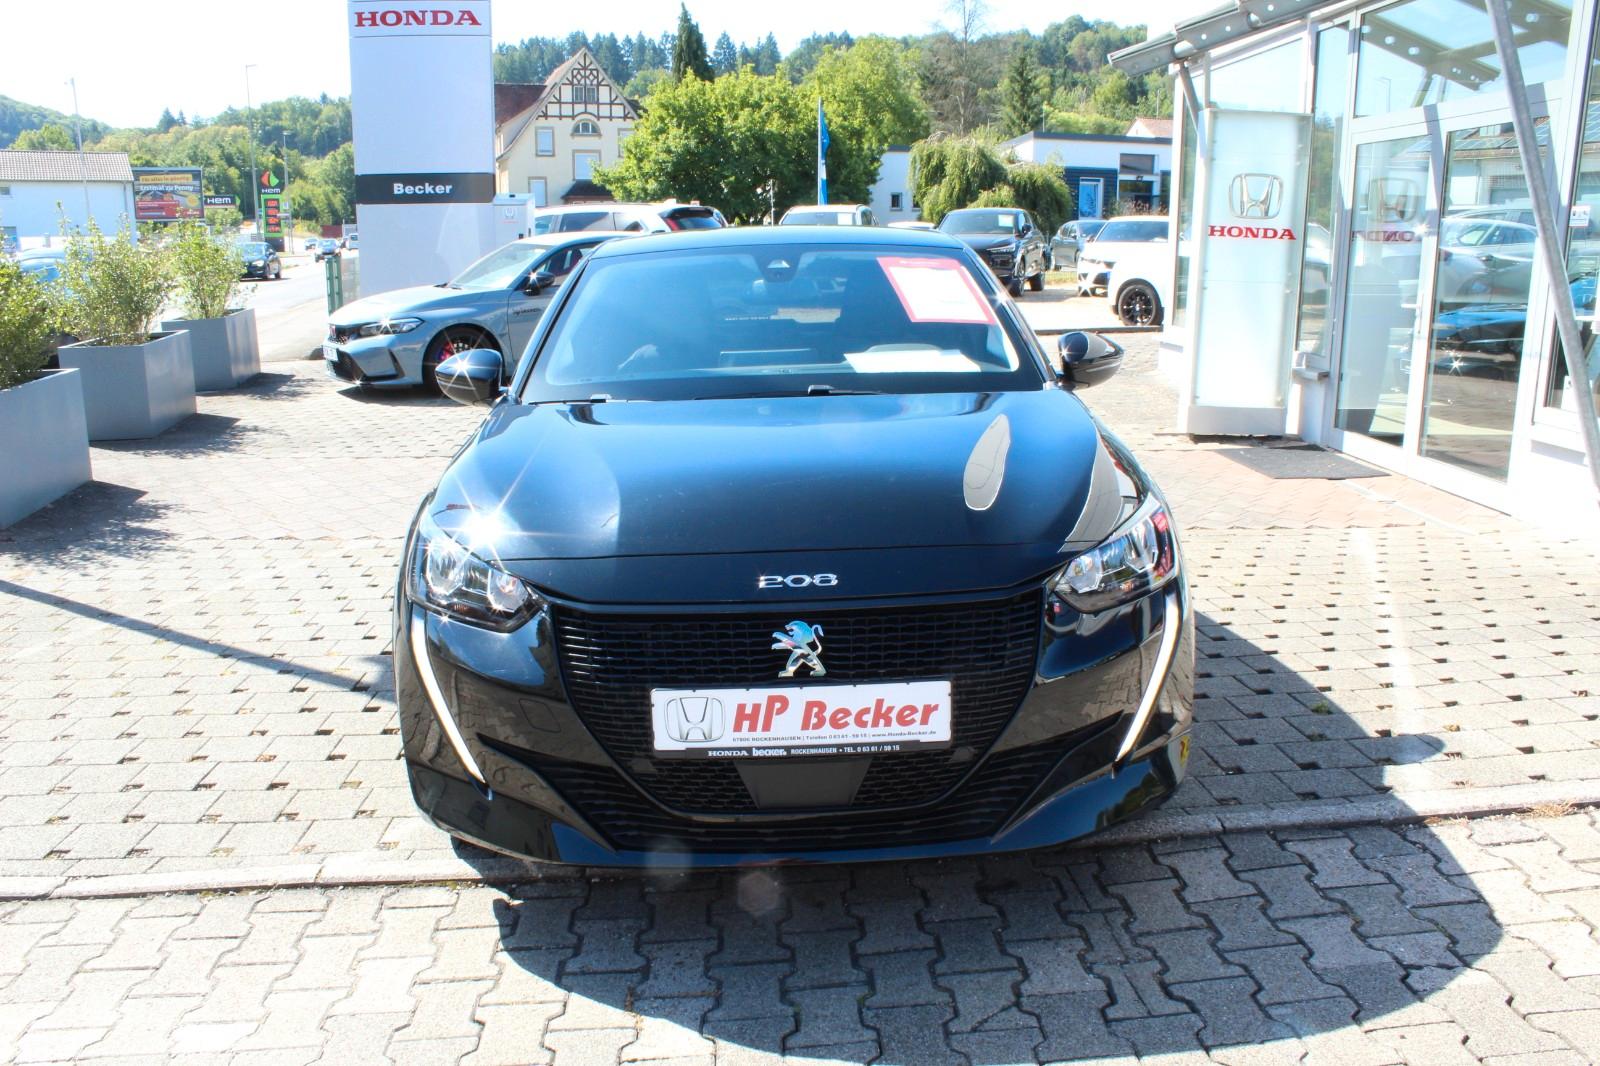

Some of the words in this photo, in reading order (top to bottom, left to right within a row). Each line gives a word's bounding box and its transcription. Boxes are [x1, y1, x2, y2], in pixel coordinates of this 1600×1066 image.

[354, 10, 482, 27] HONDA
[393, 182, 452, 195] Becker
[1208, 225, 1297, 240] HONDA
[758, 573, 839, 589] 208
[732, 694, 790, 733] HP
[800, 698, 940, 731] Becker
[790, 747, 837, 755] ROCKENHAUSEN
